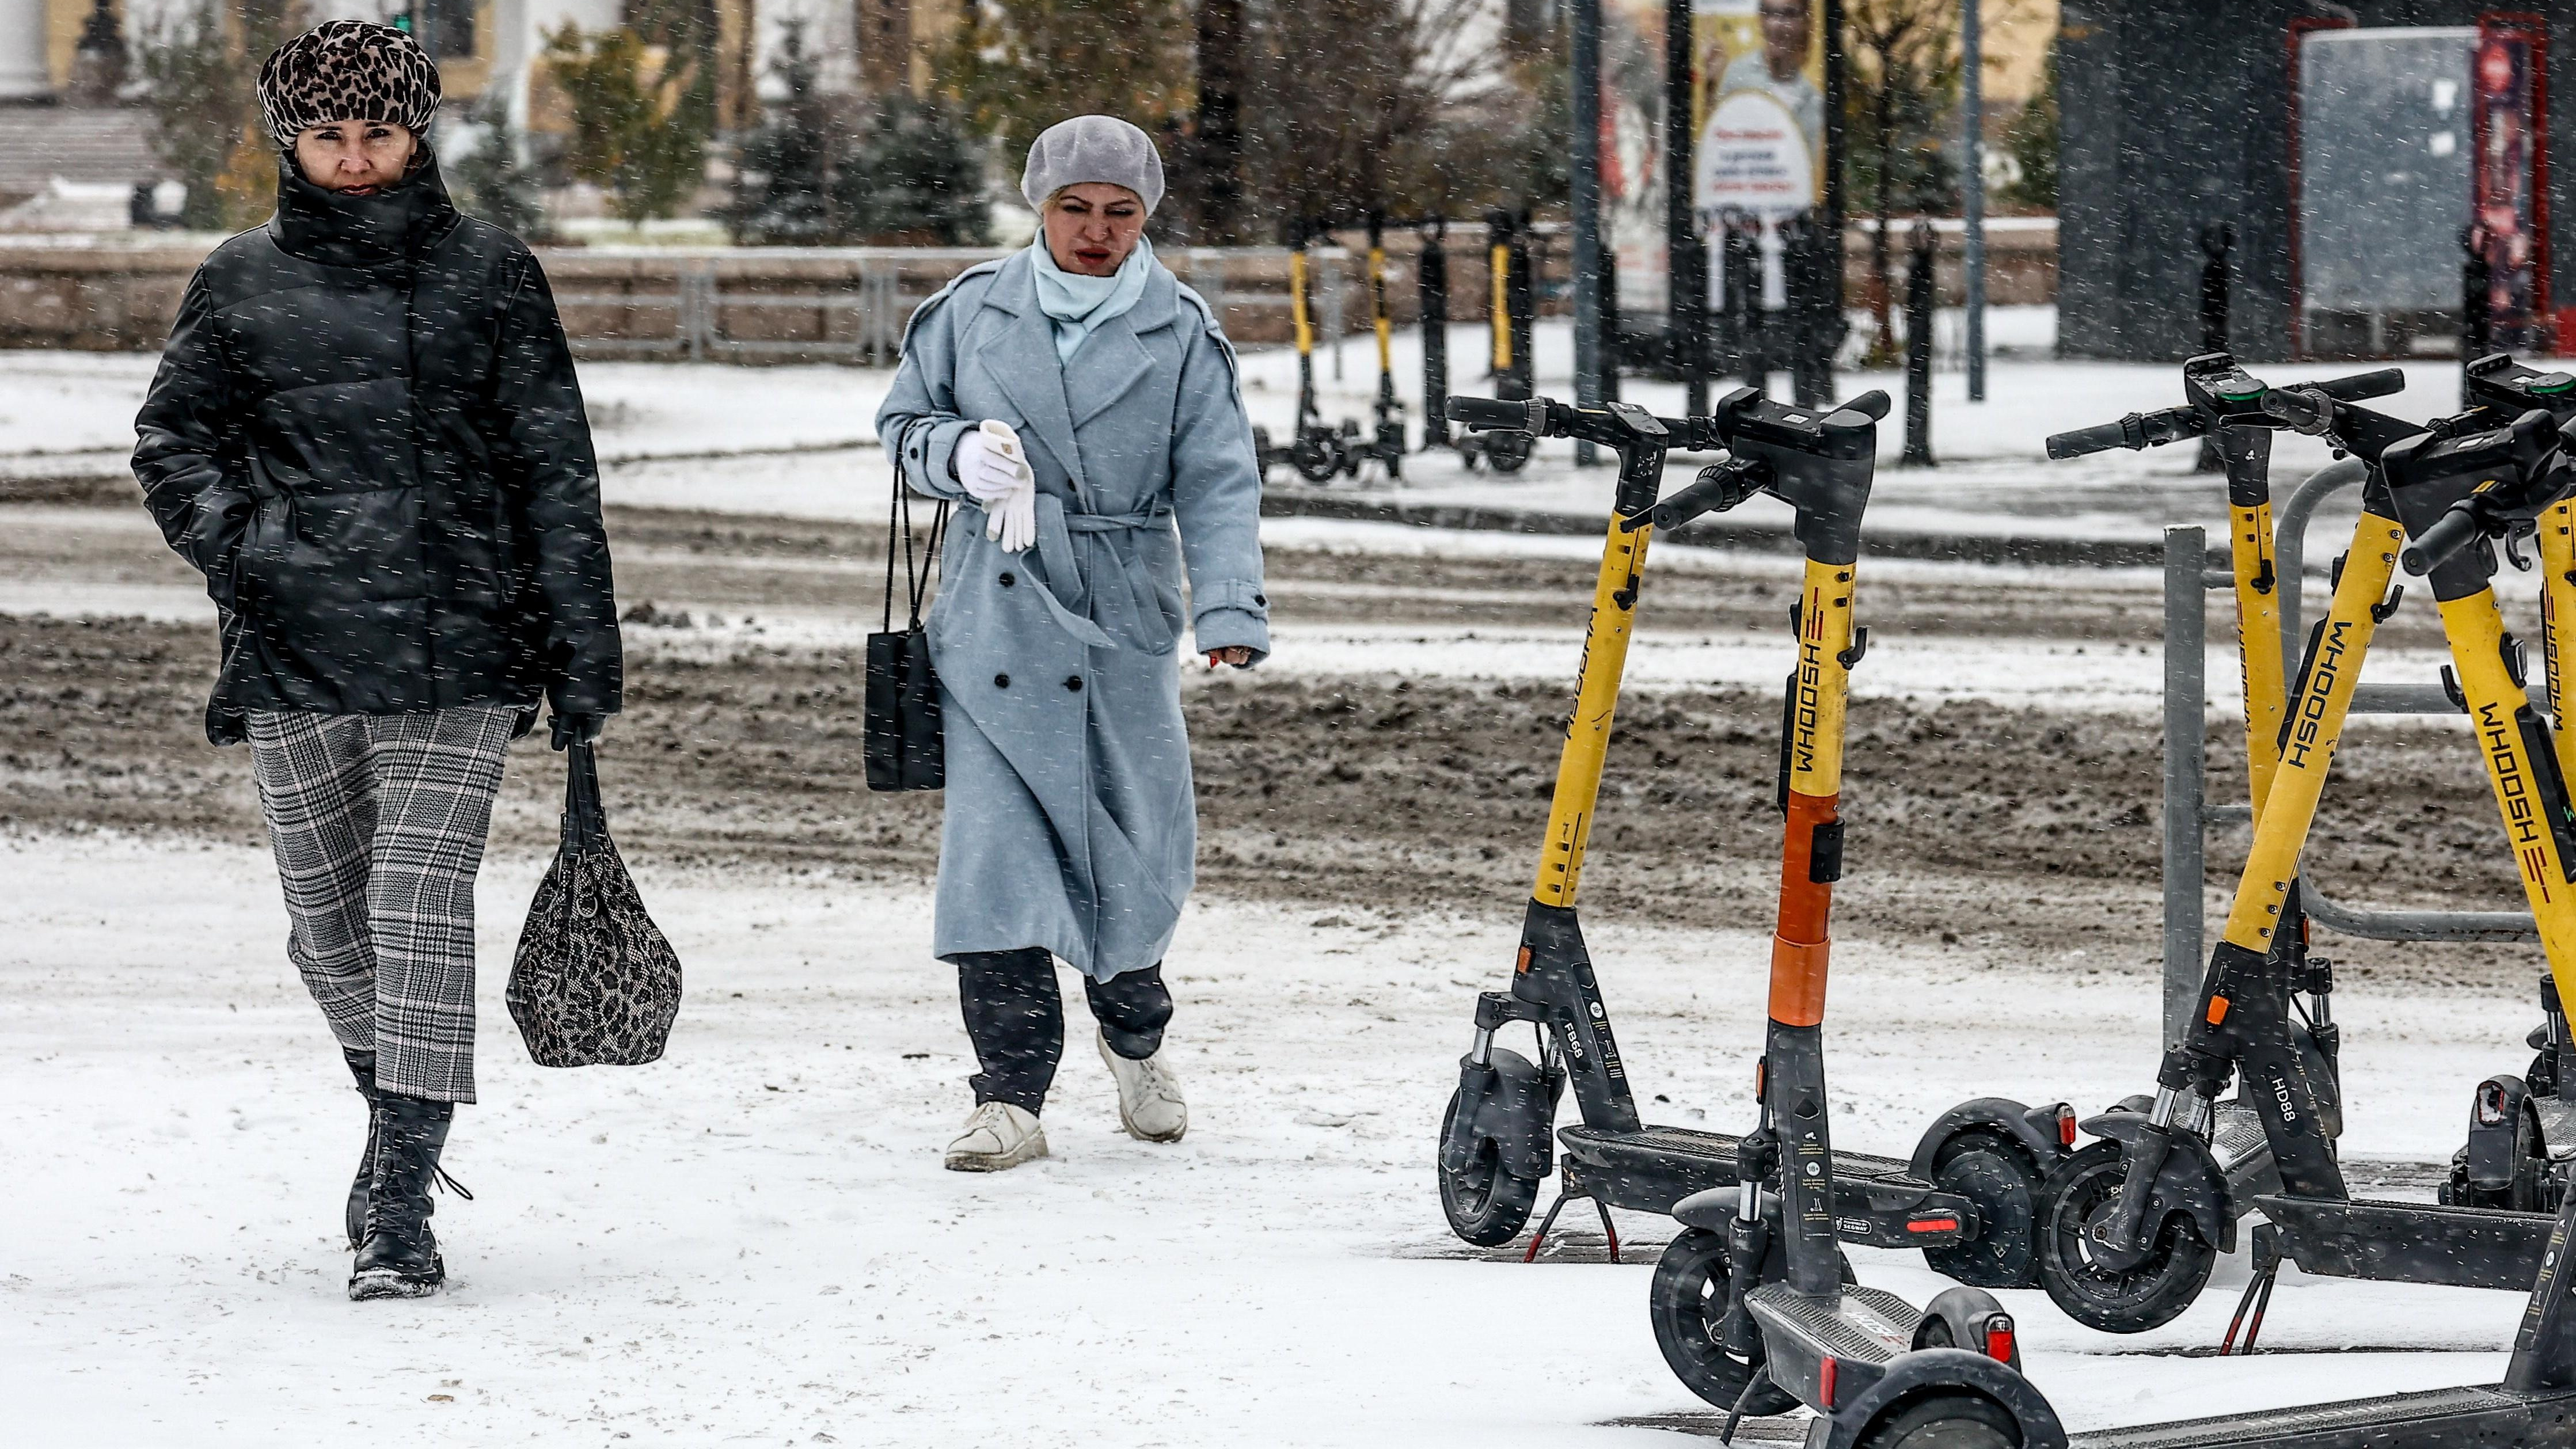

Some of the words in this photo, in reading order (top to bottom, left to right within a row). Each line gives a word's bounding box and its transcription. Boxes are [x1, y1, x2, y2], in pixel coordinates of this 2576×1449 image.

[1796, 643, 1821, 772] WHOOSH
[2288, 622, 2353, 769] WHOOSH
[2546, 623, 2564, 732] WHOOSH
[2479, 702, 2539, 843] WHOOSH
[1564, 1022, 1583, 1059] FB68
[2271, 1077, 2296, 1122] HD88
[1843, 1224, 1869, 1232] SEGWAY
